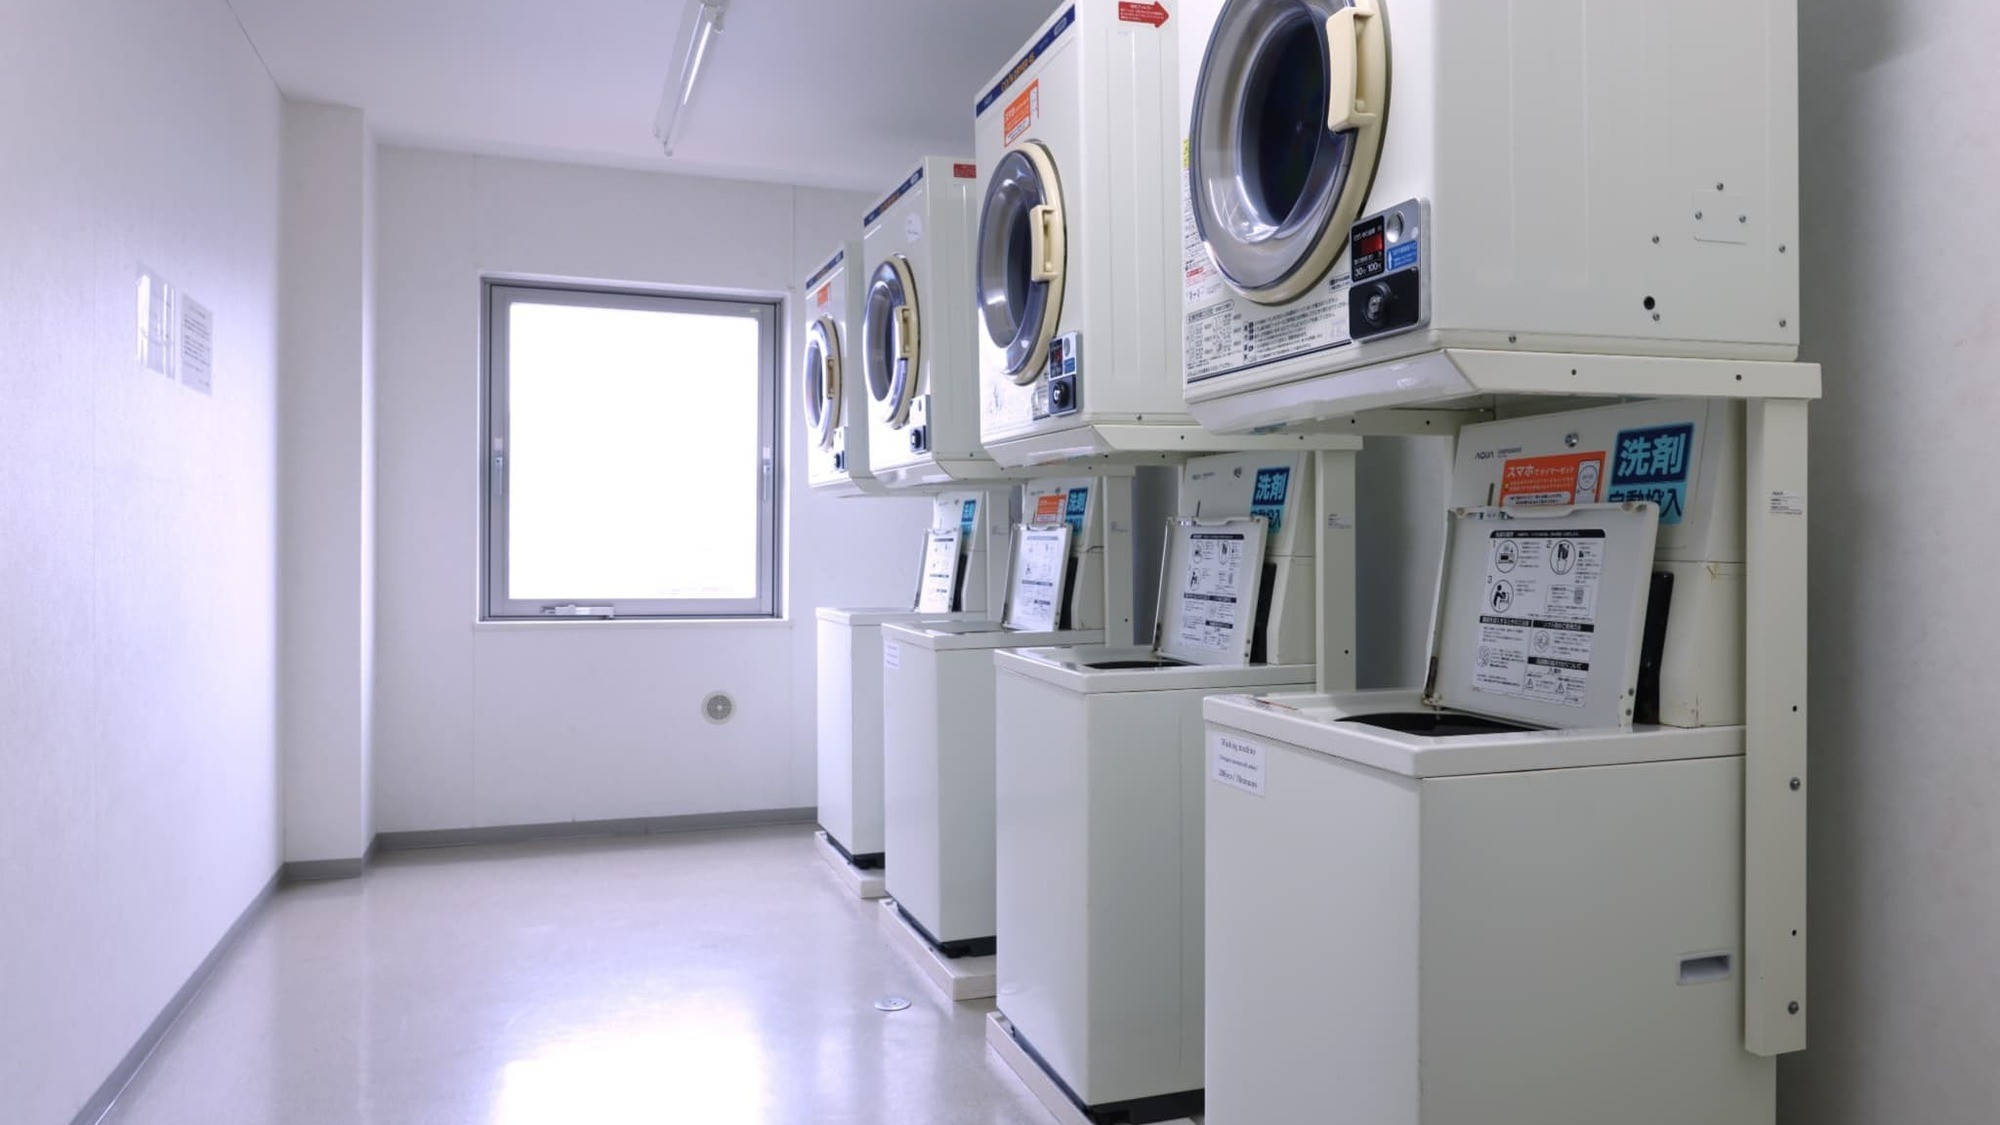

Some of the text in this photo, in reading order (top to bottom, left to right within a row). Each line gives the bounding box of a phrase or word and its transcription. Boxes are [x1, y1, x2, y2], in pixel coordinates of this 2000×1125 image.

[1474, 450, 1494, 460] AQUA
[1618, 433, 1687, 477] 洗剤
[1255, 473, 1287, 501] 洗剤
